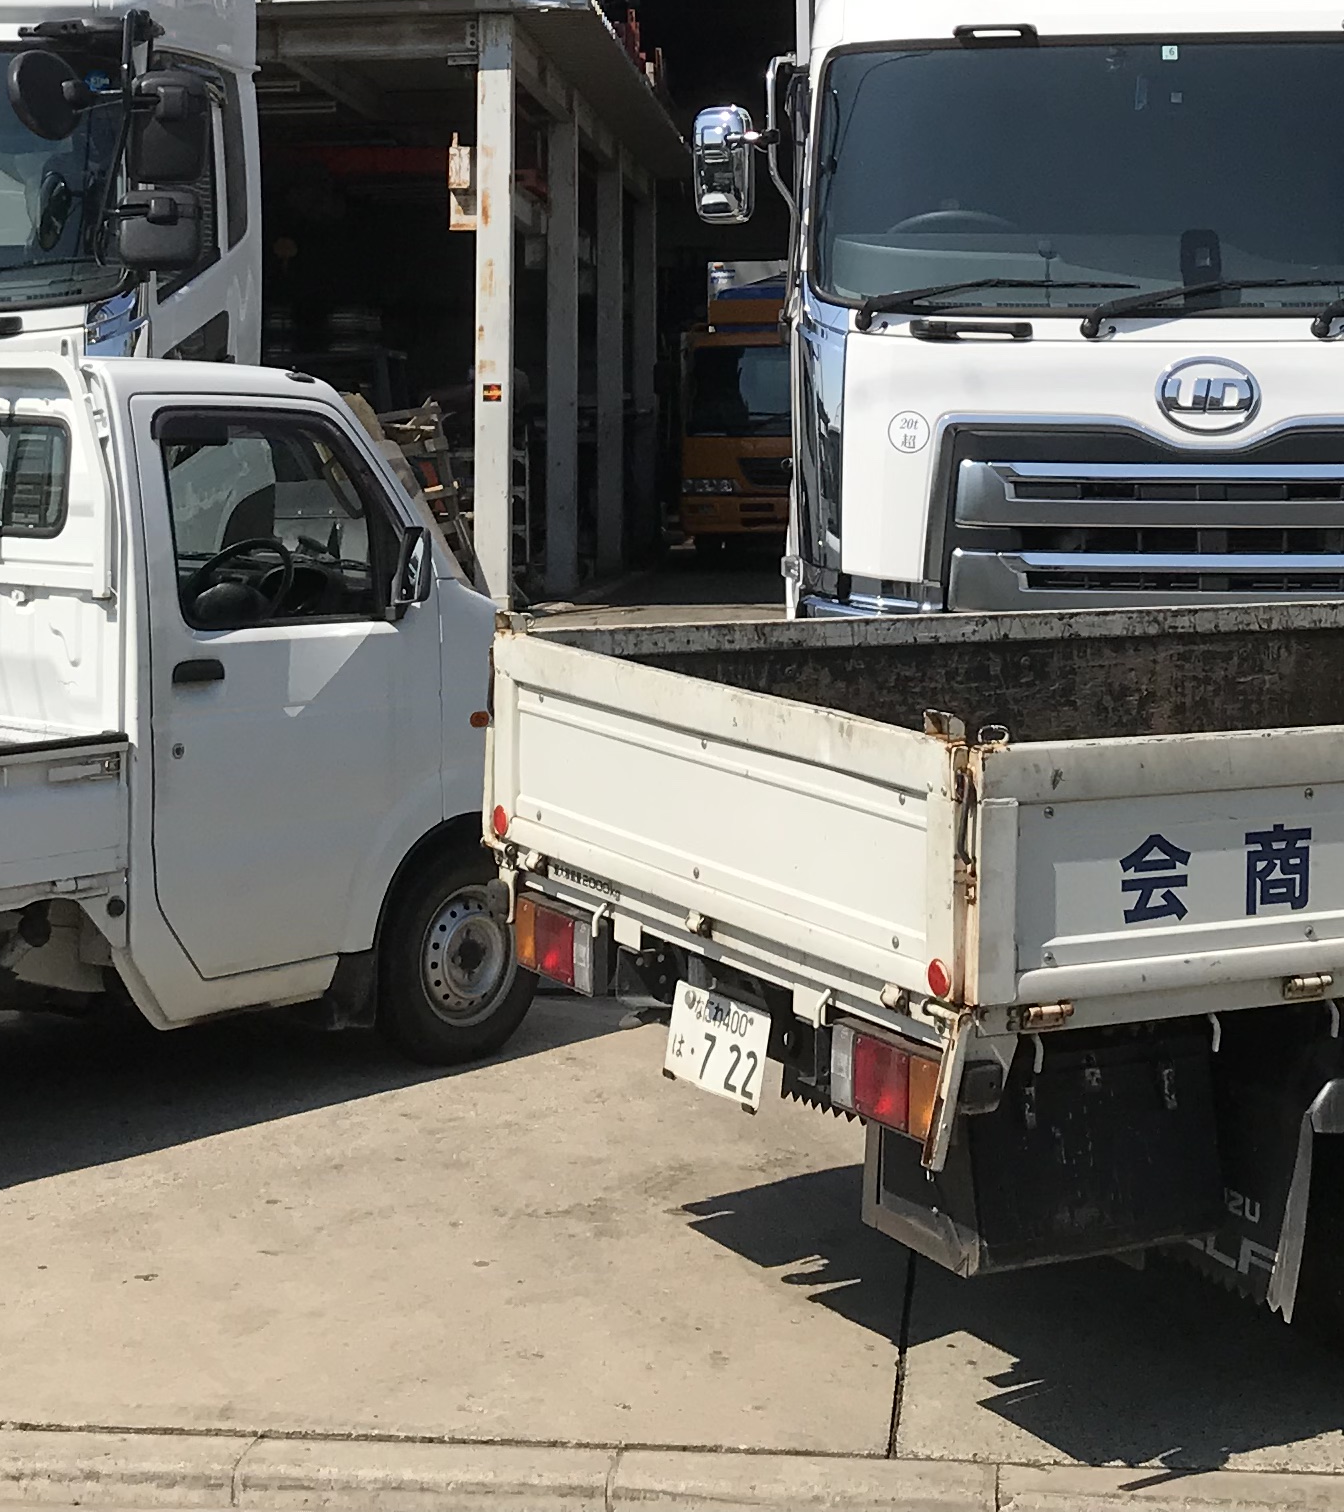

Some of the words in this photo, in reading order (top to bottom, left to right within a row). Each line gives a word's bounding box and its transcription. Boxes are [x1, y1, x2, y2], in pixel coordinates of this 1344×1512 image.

[1162, 377, 1253, 415] UD
[899, 417, 920, 430] 20t
[901, 433, 917, 449] 超
[1223, 1186, 1261, 1224] ZU
